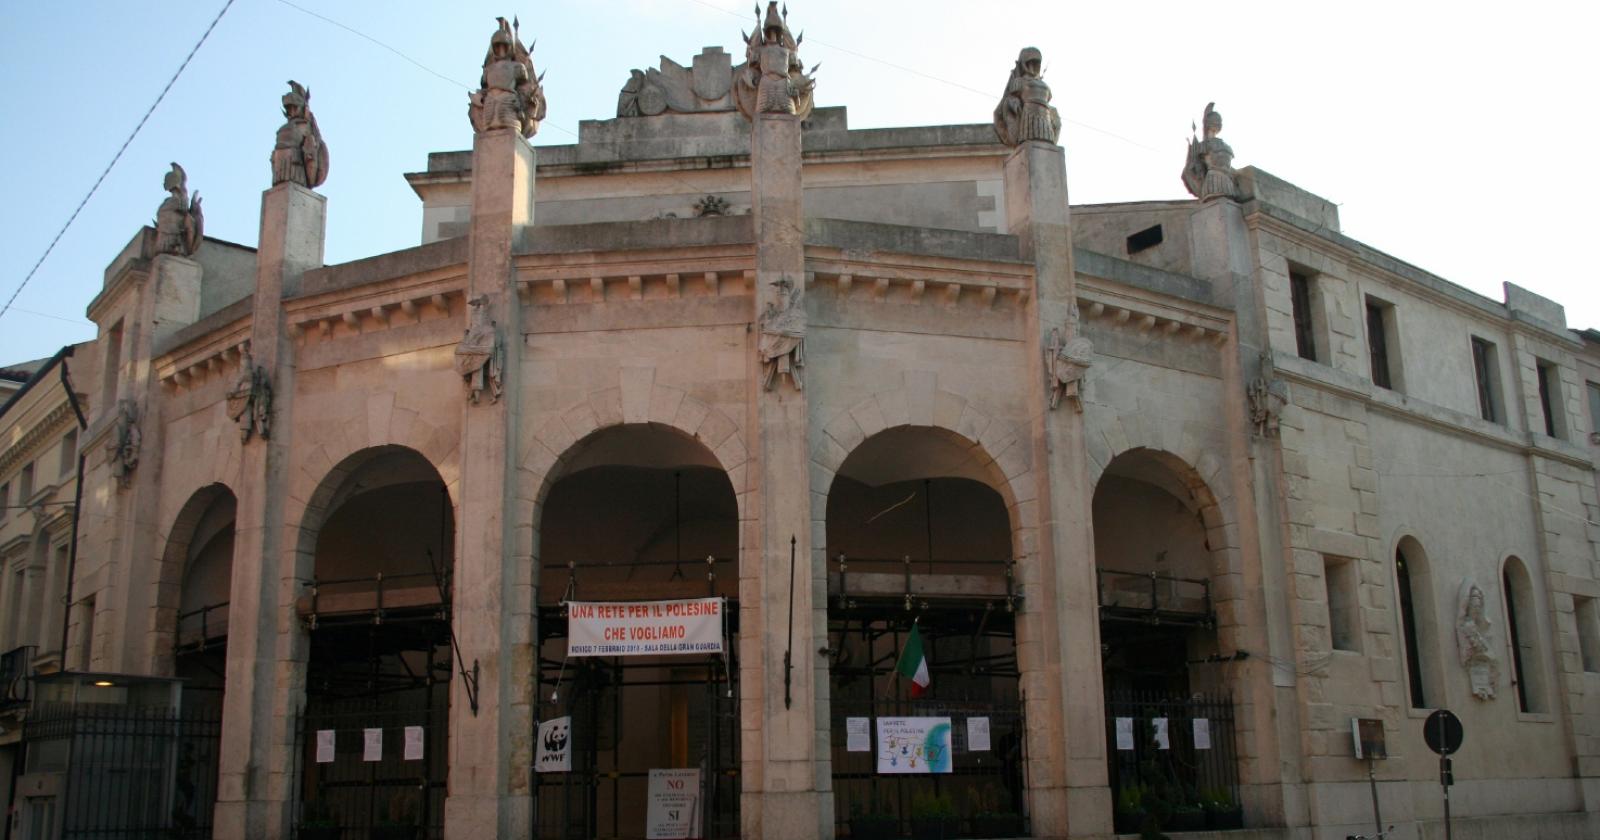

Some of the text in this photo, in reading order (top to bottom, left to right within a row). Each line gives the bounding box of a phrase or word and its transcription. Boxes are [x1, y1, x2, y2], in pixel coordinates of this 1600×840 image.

[572, 601, 719, 619] UNA RETE PER IL POLESINE
[604, 625, 686, 641] CHE VOGLIAMO
[659, 643, 677, 651] DELLA
[542, 753, 565, 762] WWF
[667, 779, 685, 790] NO
